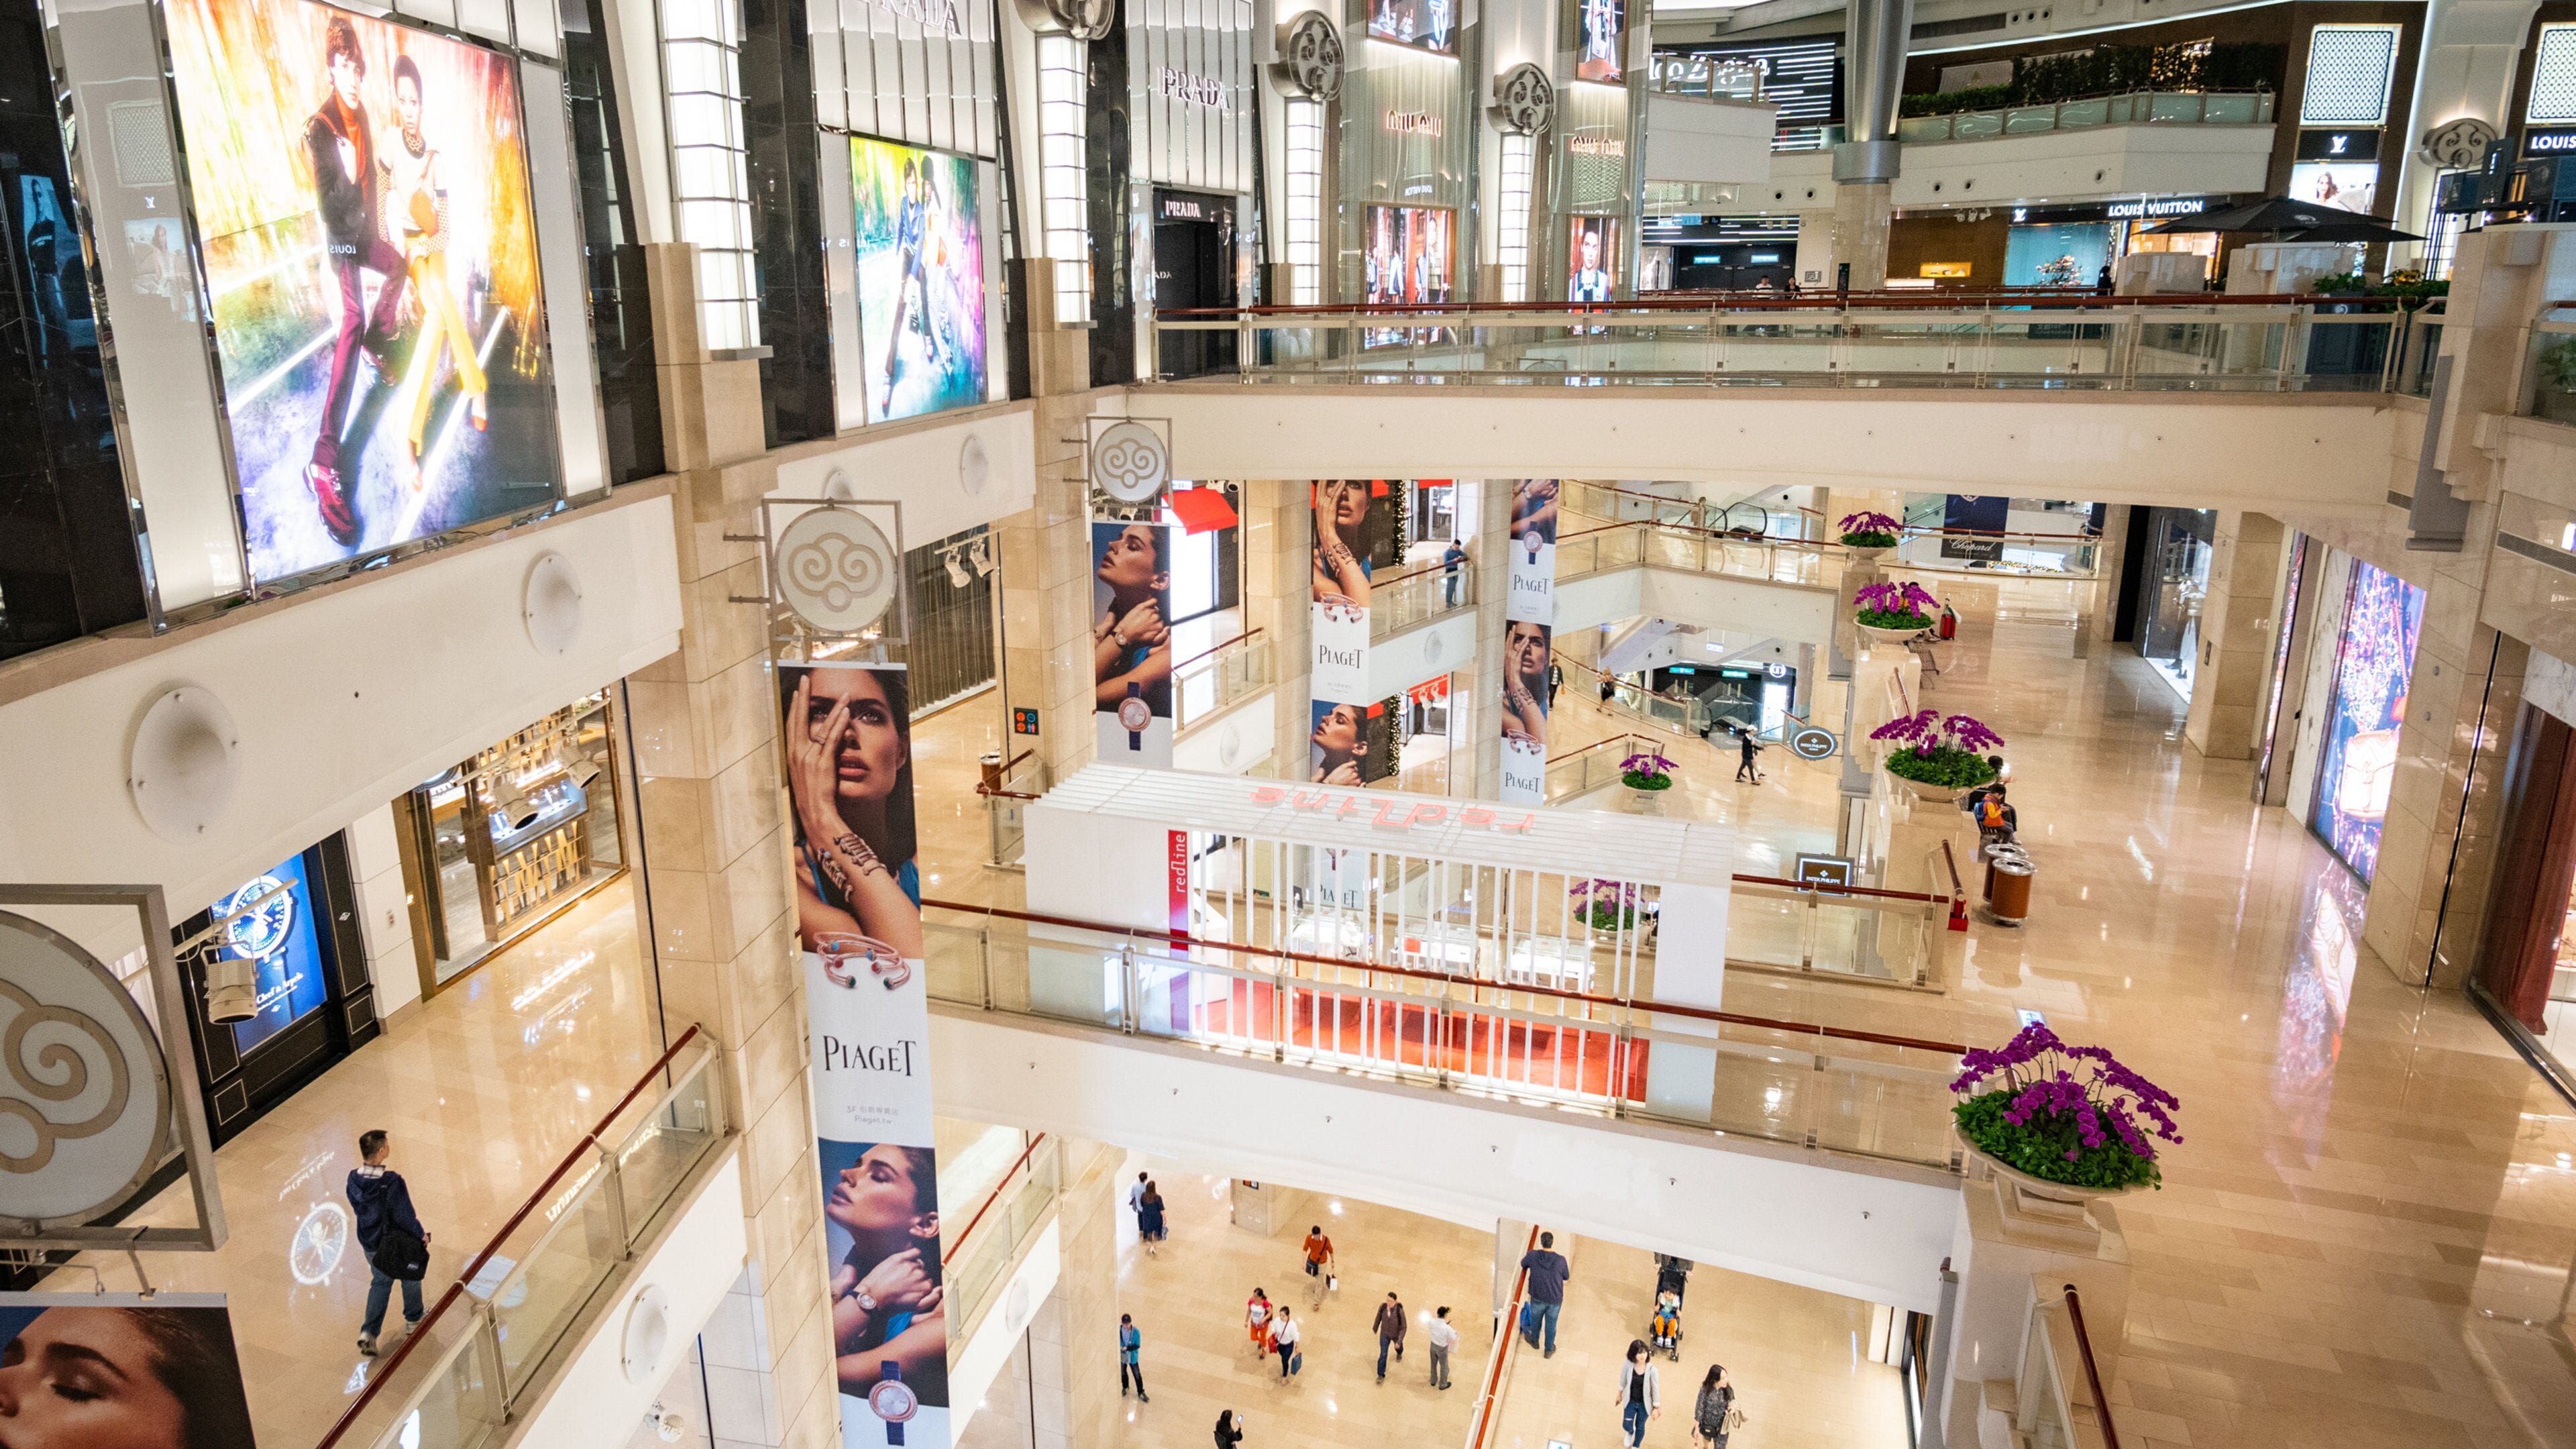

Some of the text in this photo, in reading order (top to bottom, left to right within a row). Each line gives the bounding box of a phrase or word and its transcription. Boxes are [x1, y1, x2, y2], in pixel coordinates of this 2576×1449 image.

[874, 0, 961, 35] ADA
[1159, 66, 1230, 109] PRADA
[2531, 136, 2576, 150] LOUIS
[1165, 201, 1202, 217] PRADA
[2108, 201, 2190, 216] LOUIS VUITTON
[1949, 539, 1996, 551] Chopard
[1513, 574, 1550, 594] PIAGET
[1319, 645, 1363, 669] PIAGET
[1505, 772, 1541, 792] PIAGET
[1320, 884, 1358, 908] IAET
[256, 987, 275, 1004] Cleef
[282, 972, 304, 989] Arpels
[823, 1035, 917, 1076] PIAGET
